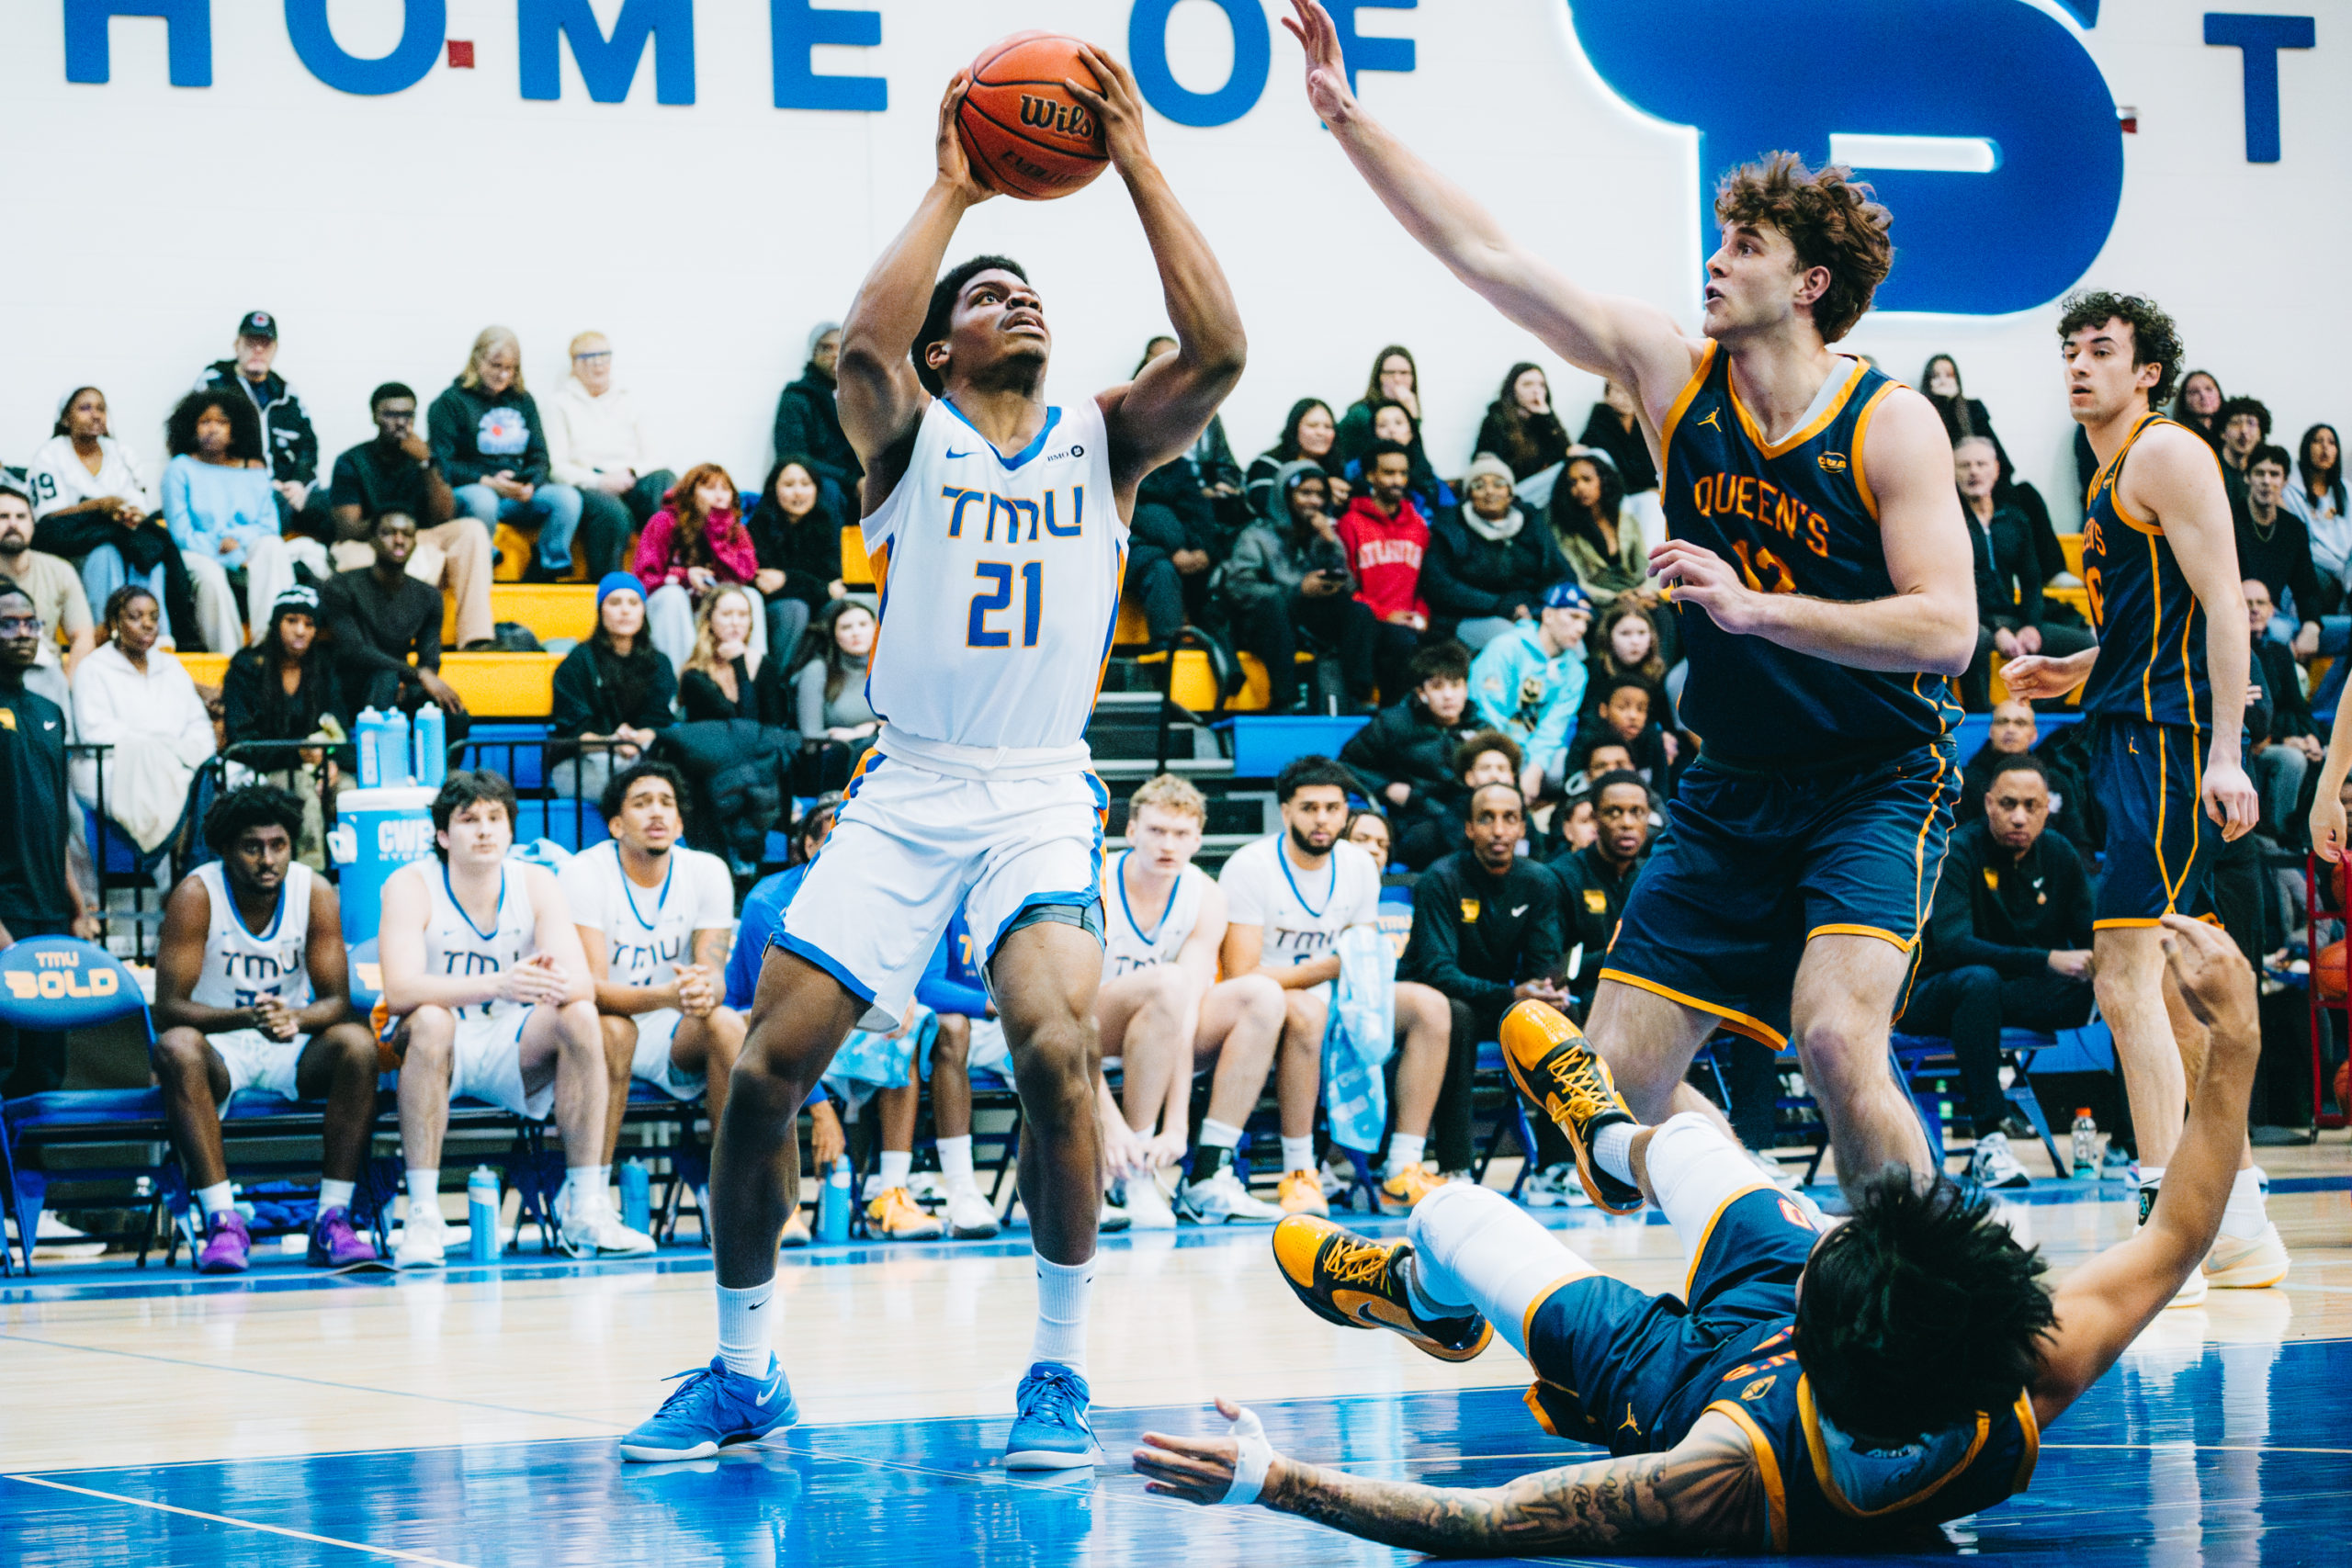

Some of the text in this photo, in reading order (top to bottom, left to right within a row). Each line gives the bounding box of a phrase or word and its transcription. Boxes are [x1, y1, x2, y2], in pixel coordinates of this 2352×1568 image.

[1129, 0, 1418, 130] OF
[1020, 95, 1102, 141] Wils
[1047, 451, 1069, 462] BMO
[941, 484, 1084, 544] TMU
[1694, 472, 1829, 558] QUEEN'S
[966, 559, 1044, 649] 21
[378, 819, 436, 852] CWE
[35, 952, 79, 968] TMU
[221, 949, 300, 979] TMU
[444, 951, 520, 976] TM
[4, 968, 119, 999] BOLD
